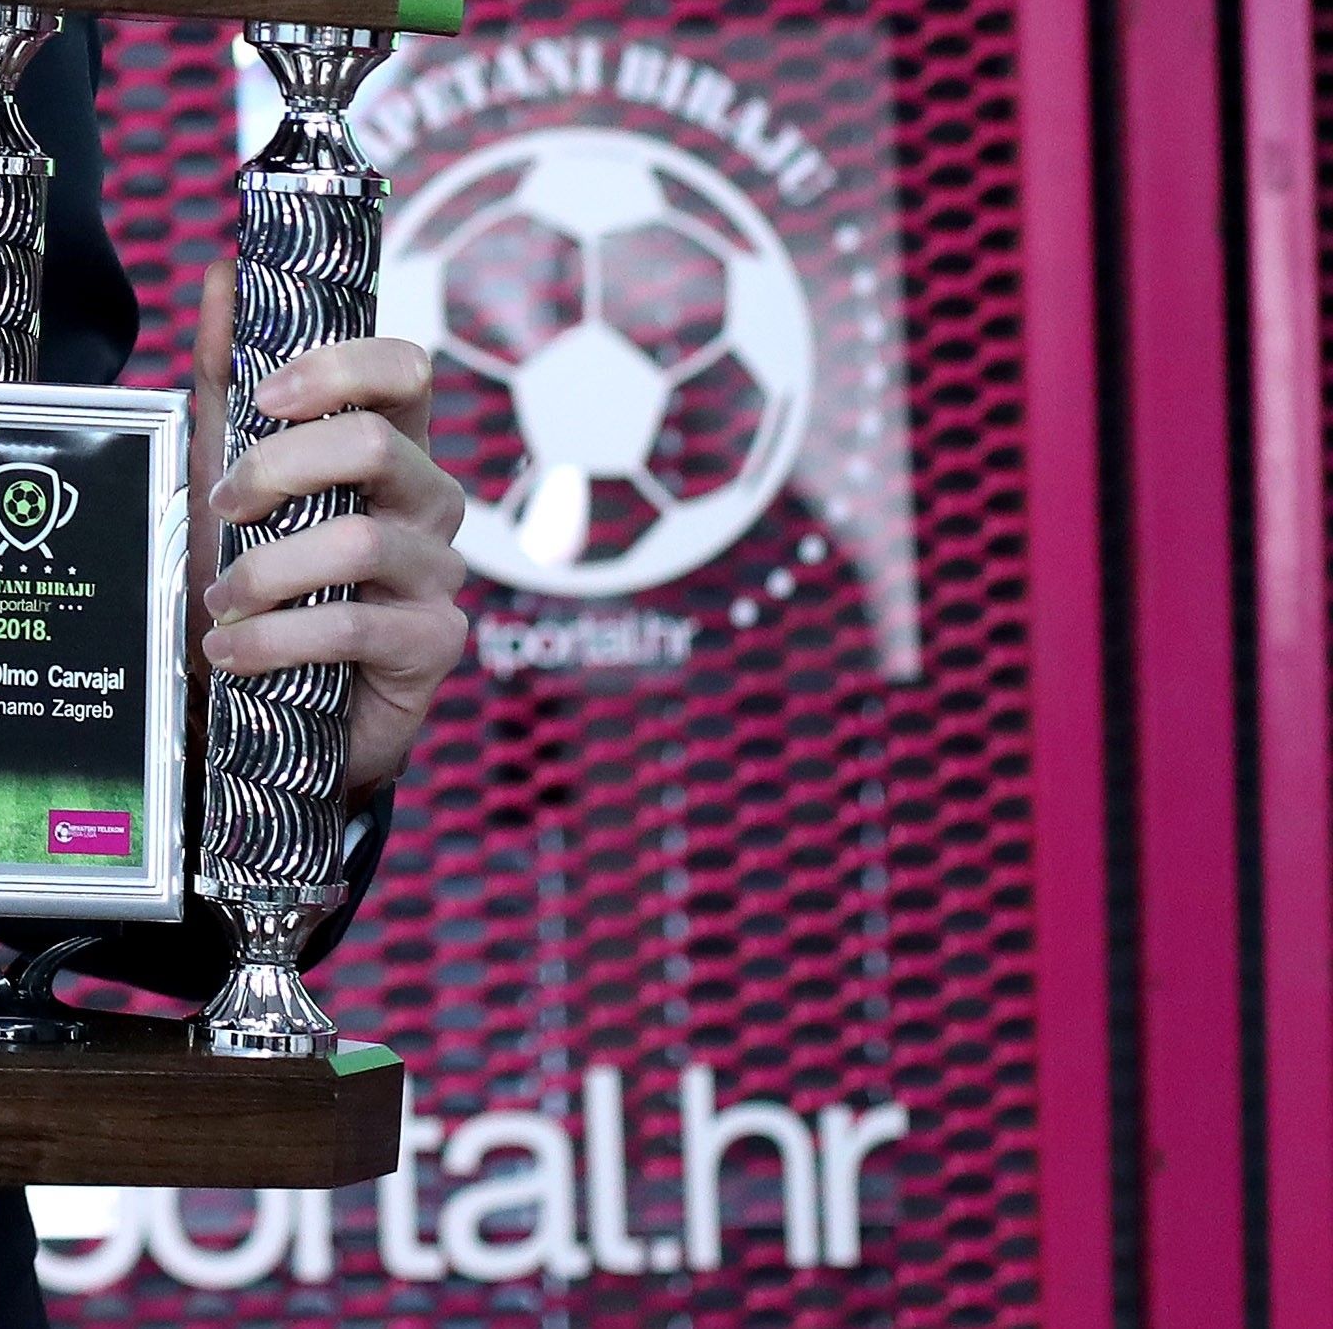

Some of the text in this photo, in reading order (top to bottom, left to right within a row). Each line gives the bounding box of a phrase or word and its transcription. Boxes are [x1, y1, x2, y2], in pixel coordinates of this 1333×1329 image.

[36, 581, 96, 597] BIRAJU
[47, 665, 125, 695] Carvajal
[51, 699, 114, 722] Zagreb
